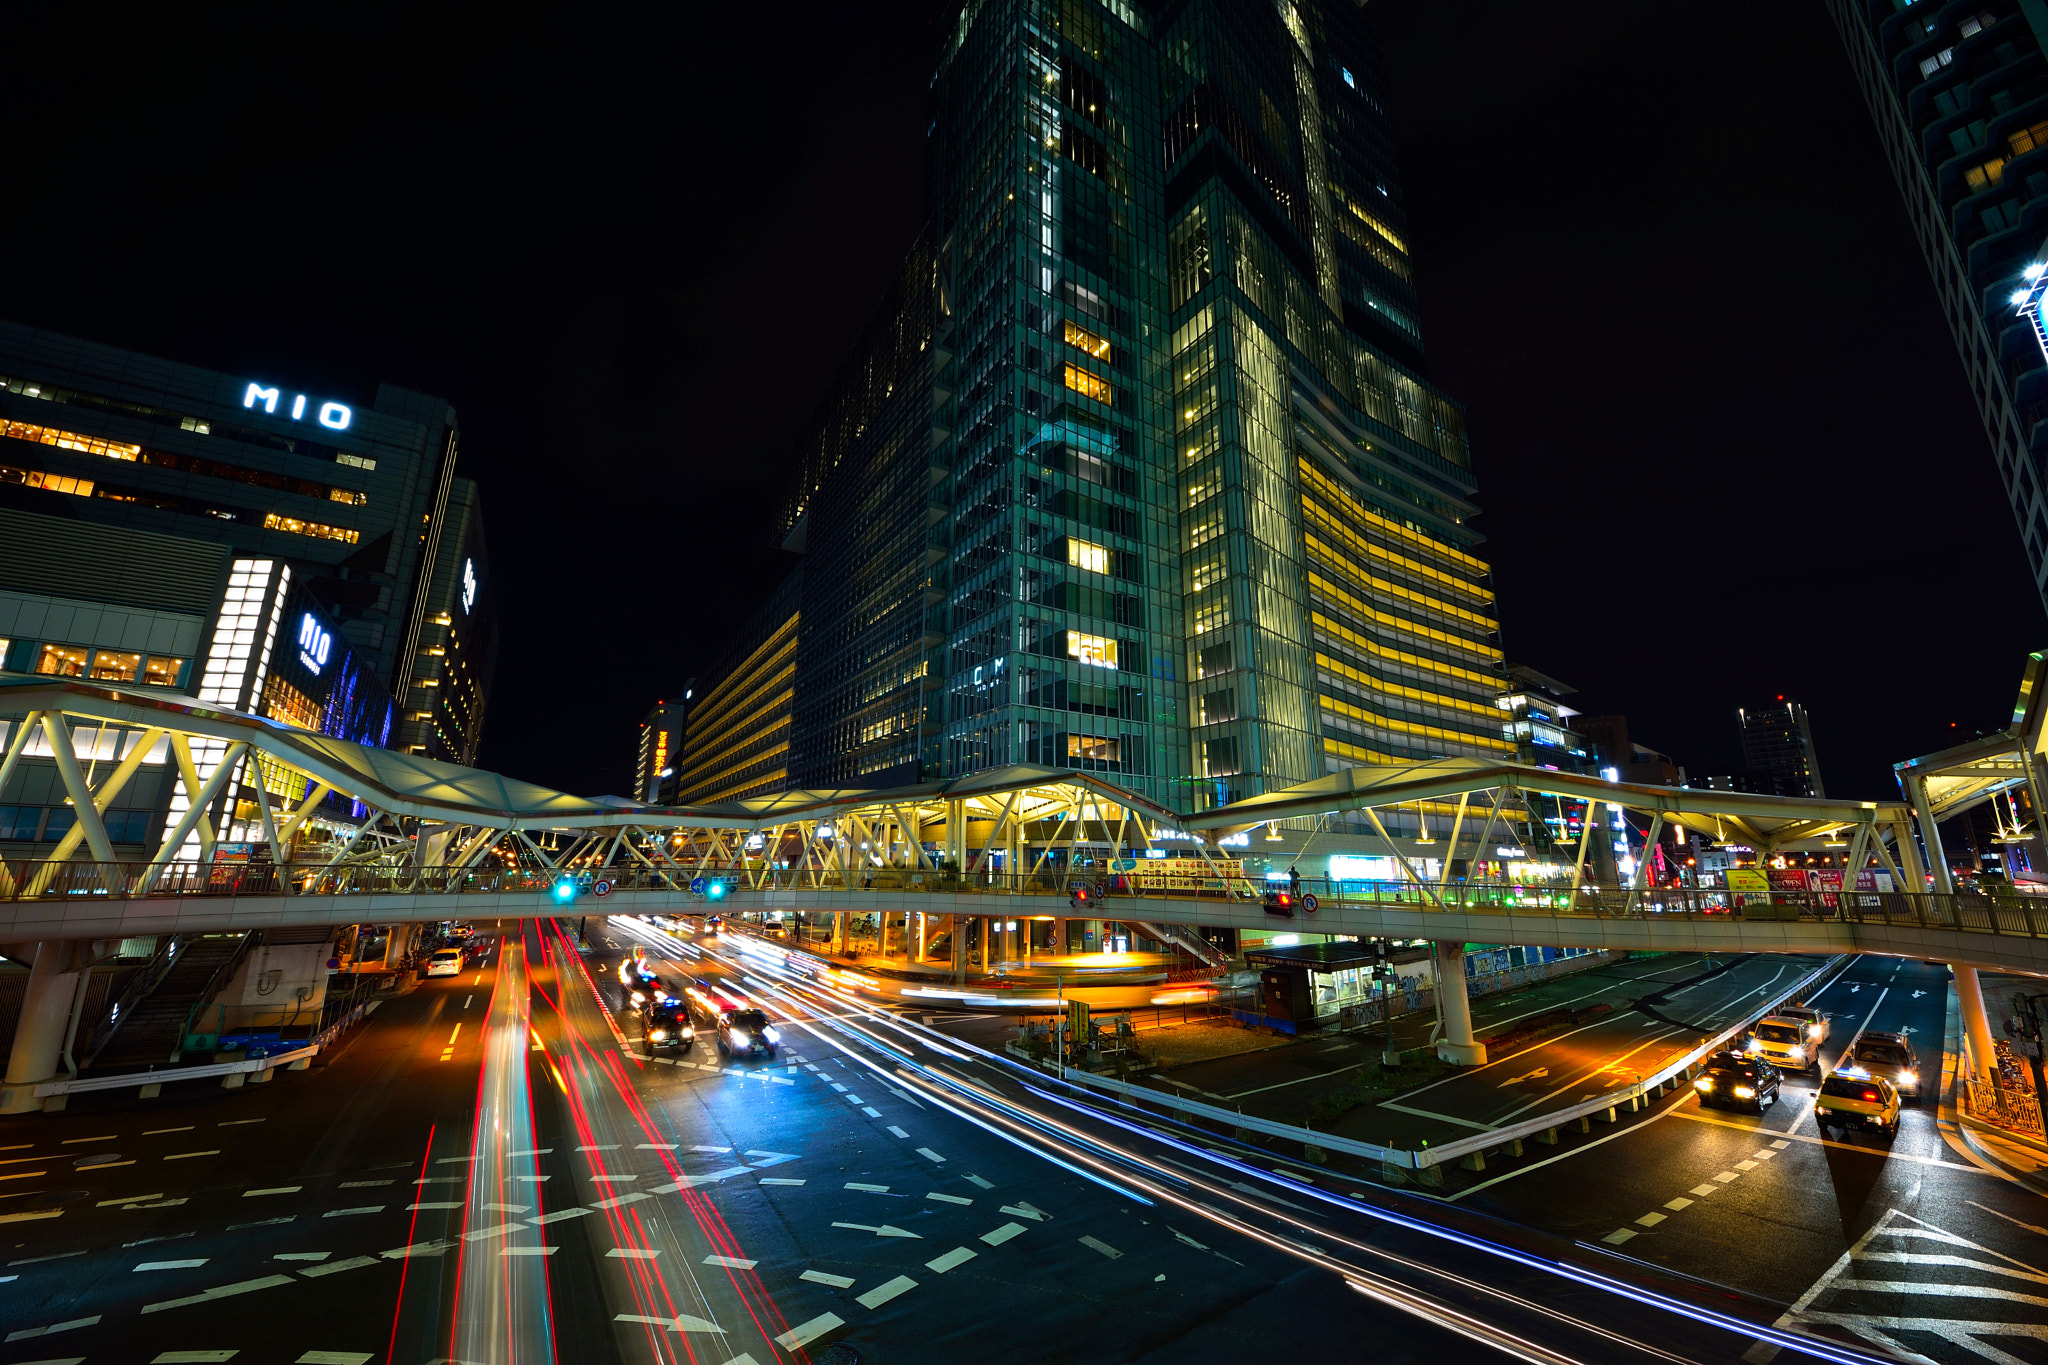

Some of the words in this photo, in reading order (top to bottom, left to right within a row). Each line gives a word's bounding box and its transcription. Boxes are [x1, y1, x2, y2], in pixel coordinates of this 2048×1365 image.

[243, 382, 352, 430] MIO
[299, 612, 331, 665] MIO
[1781, 879, 1802, 887] OPEN
